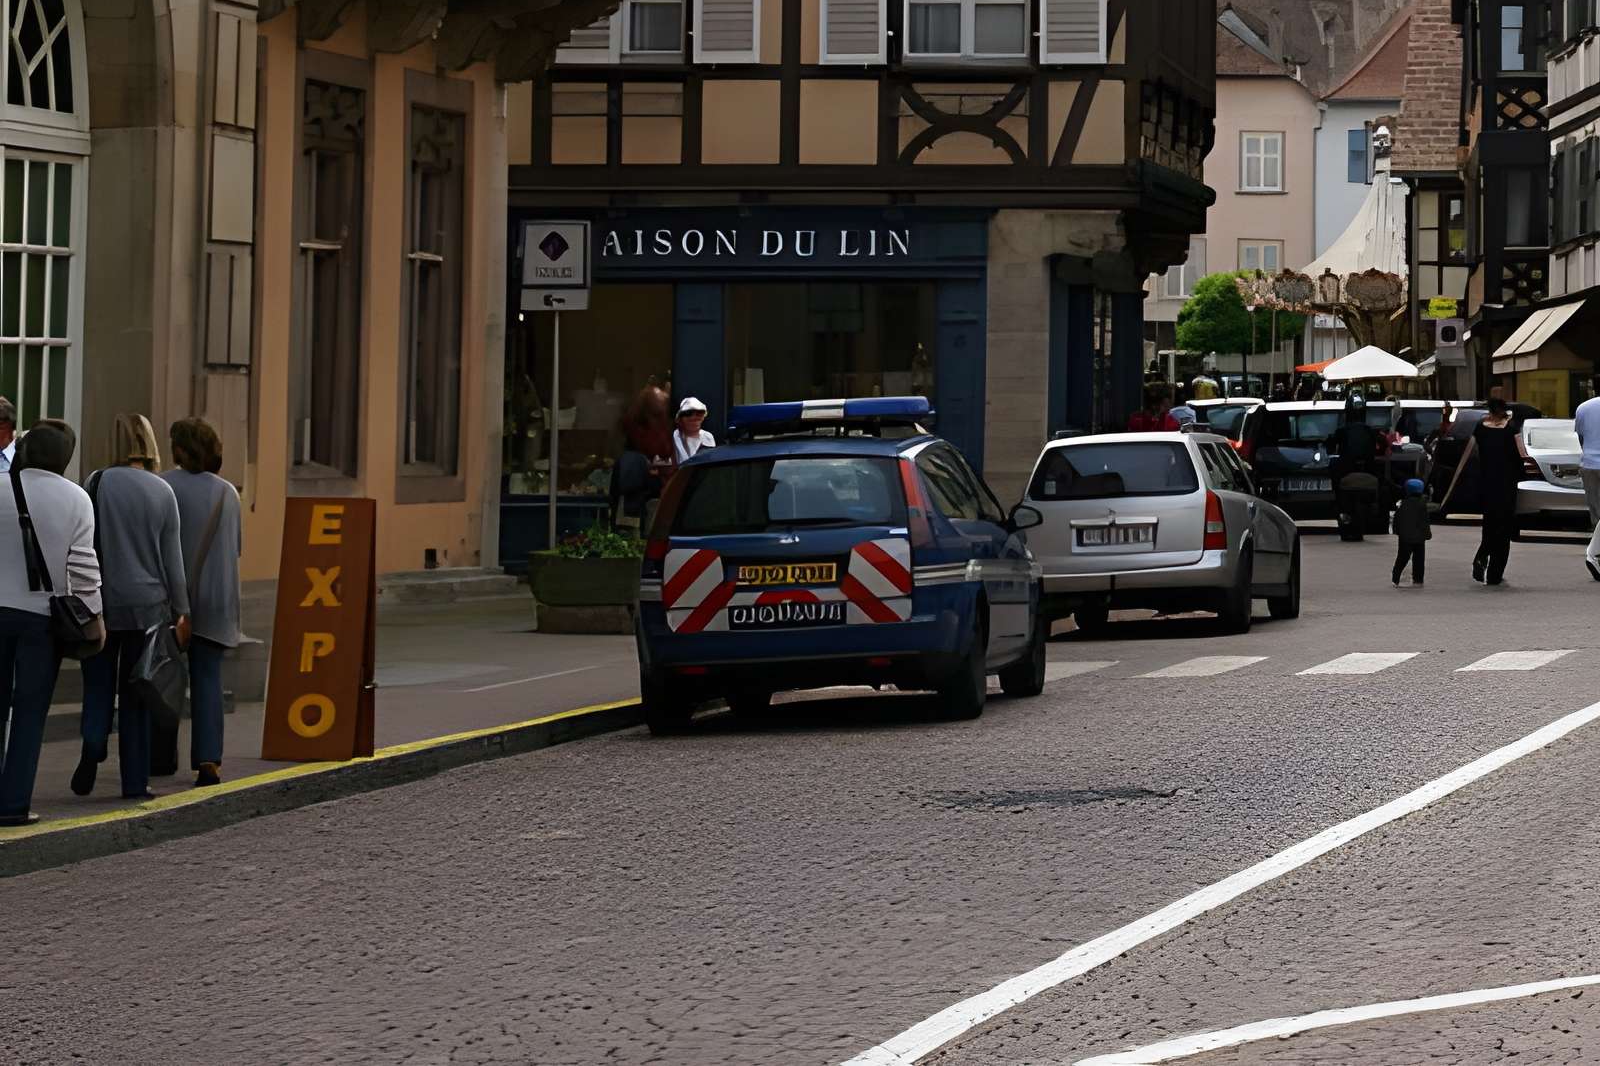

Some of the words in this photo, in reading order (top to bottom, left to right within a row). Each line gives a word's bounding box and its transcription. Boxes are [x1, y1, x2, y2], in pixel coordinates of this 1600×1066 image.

[602, 229, 738, 257] AISON
[760, 230, 816, 257] DU
[838, 229, 911, 257] LIN
[286, 504, 346, 739] EXPO
